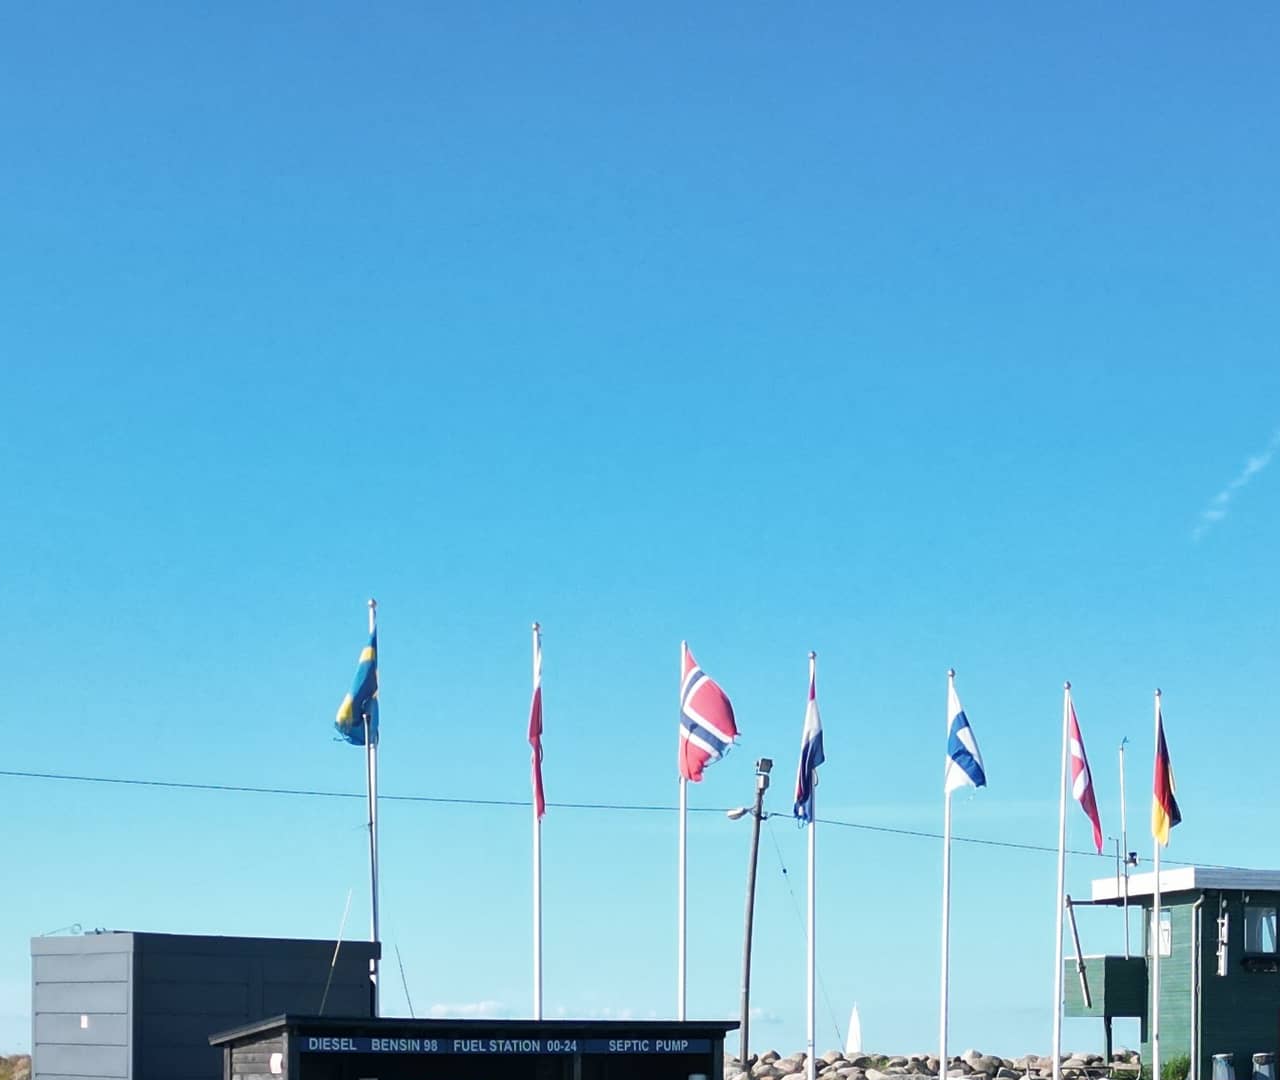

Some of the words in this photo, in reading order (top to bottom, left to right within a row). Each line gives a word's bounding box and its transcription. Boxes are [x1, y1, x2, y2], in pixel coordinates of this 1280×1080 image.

[309, 1038, 357, 1050] DIESEL
[371, 1039, 420, 1051] BENSIN
[423, 1040, 438, 1051] 98
[454, 1040, 486, 1052] FUEL
[489, 1040, 540, 1052] STATION
[547, 1040, 577, 1051] 00-24
[609, 1040, 649, 1051] SEPTIC
[656, 1040, 688, 1051] PUMP
